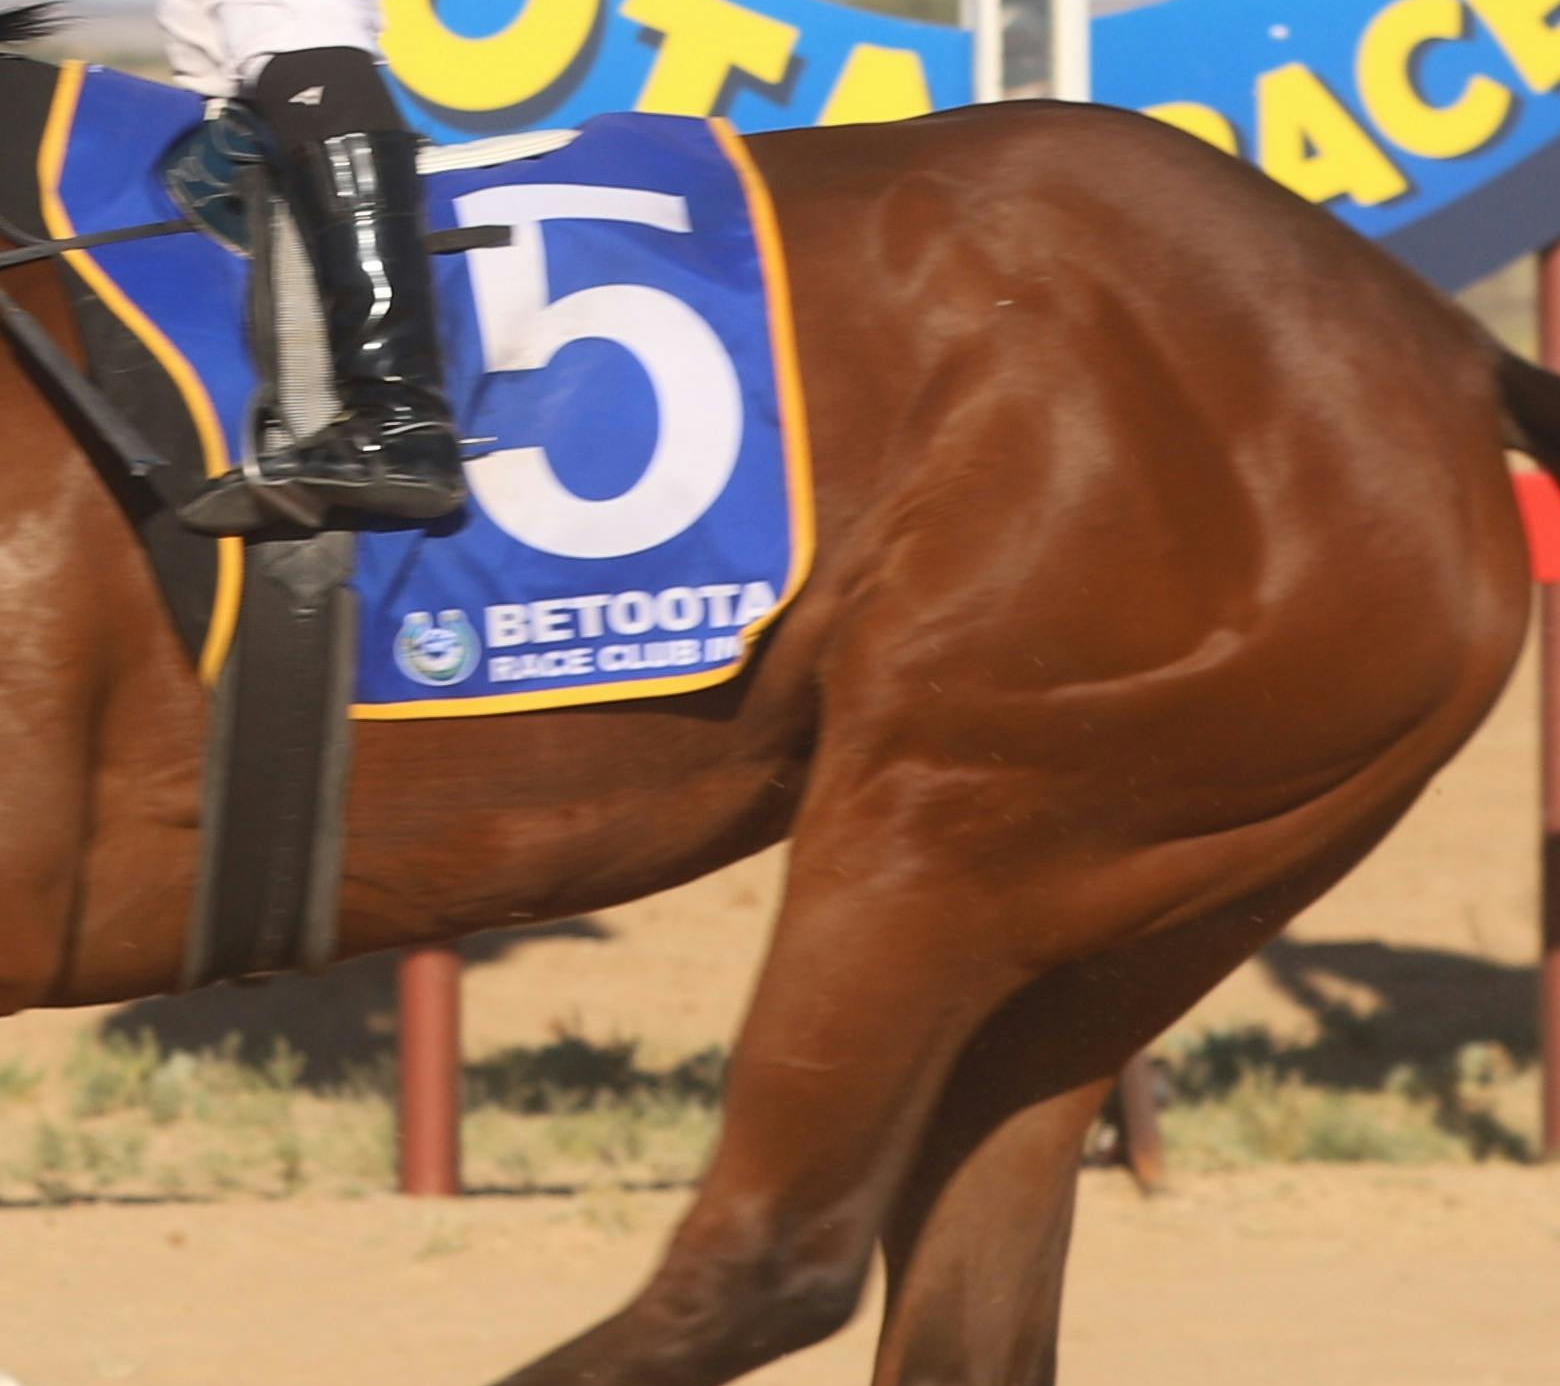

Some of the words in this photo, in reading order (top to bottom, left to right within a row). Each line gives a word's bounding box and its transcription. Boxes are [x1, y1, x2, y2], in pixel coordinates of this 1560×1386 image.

[454, 184, 744, 559] 5
[483, 580, 778, 647] BETOOTA
[488, 647, 596, 683] RACE
[596, 639, 702, 672] CLUB
